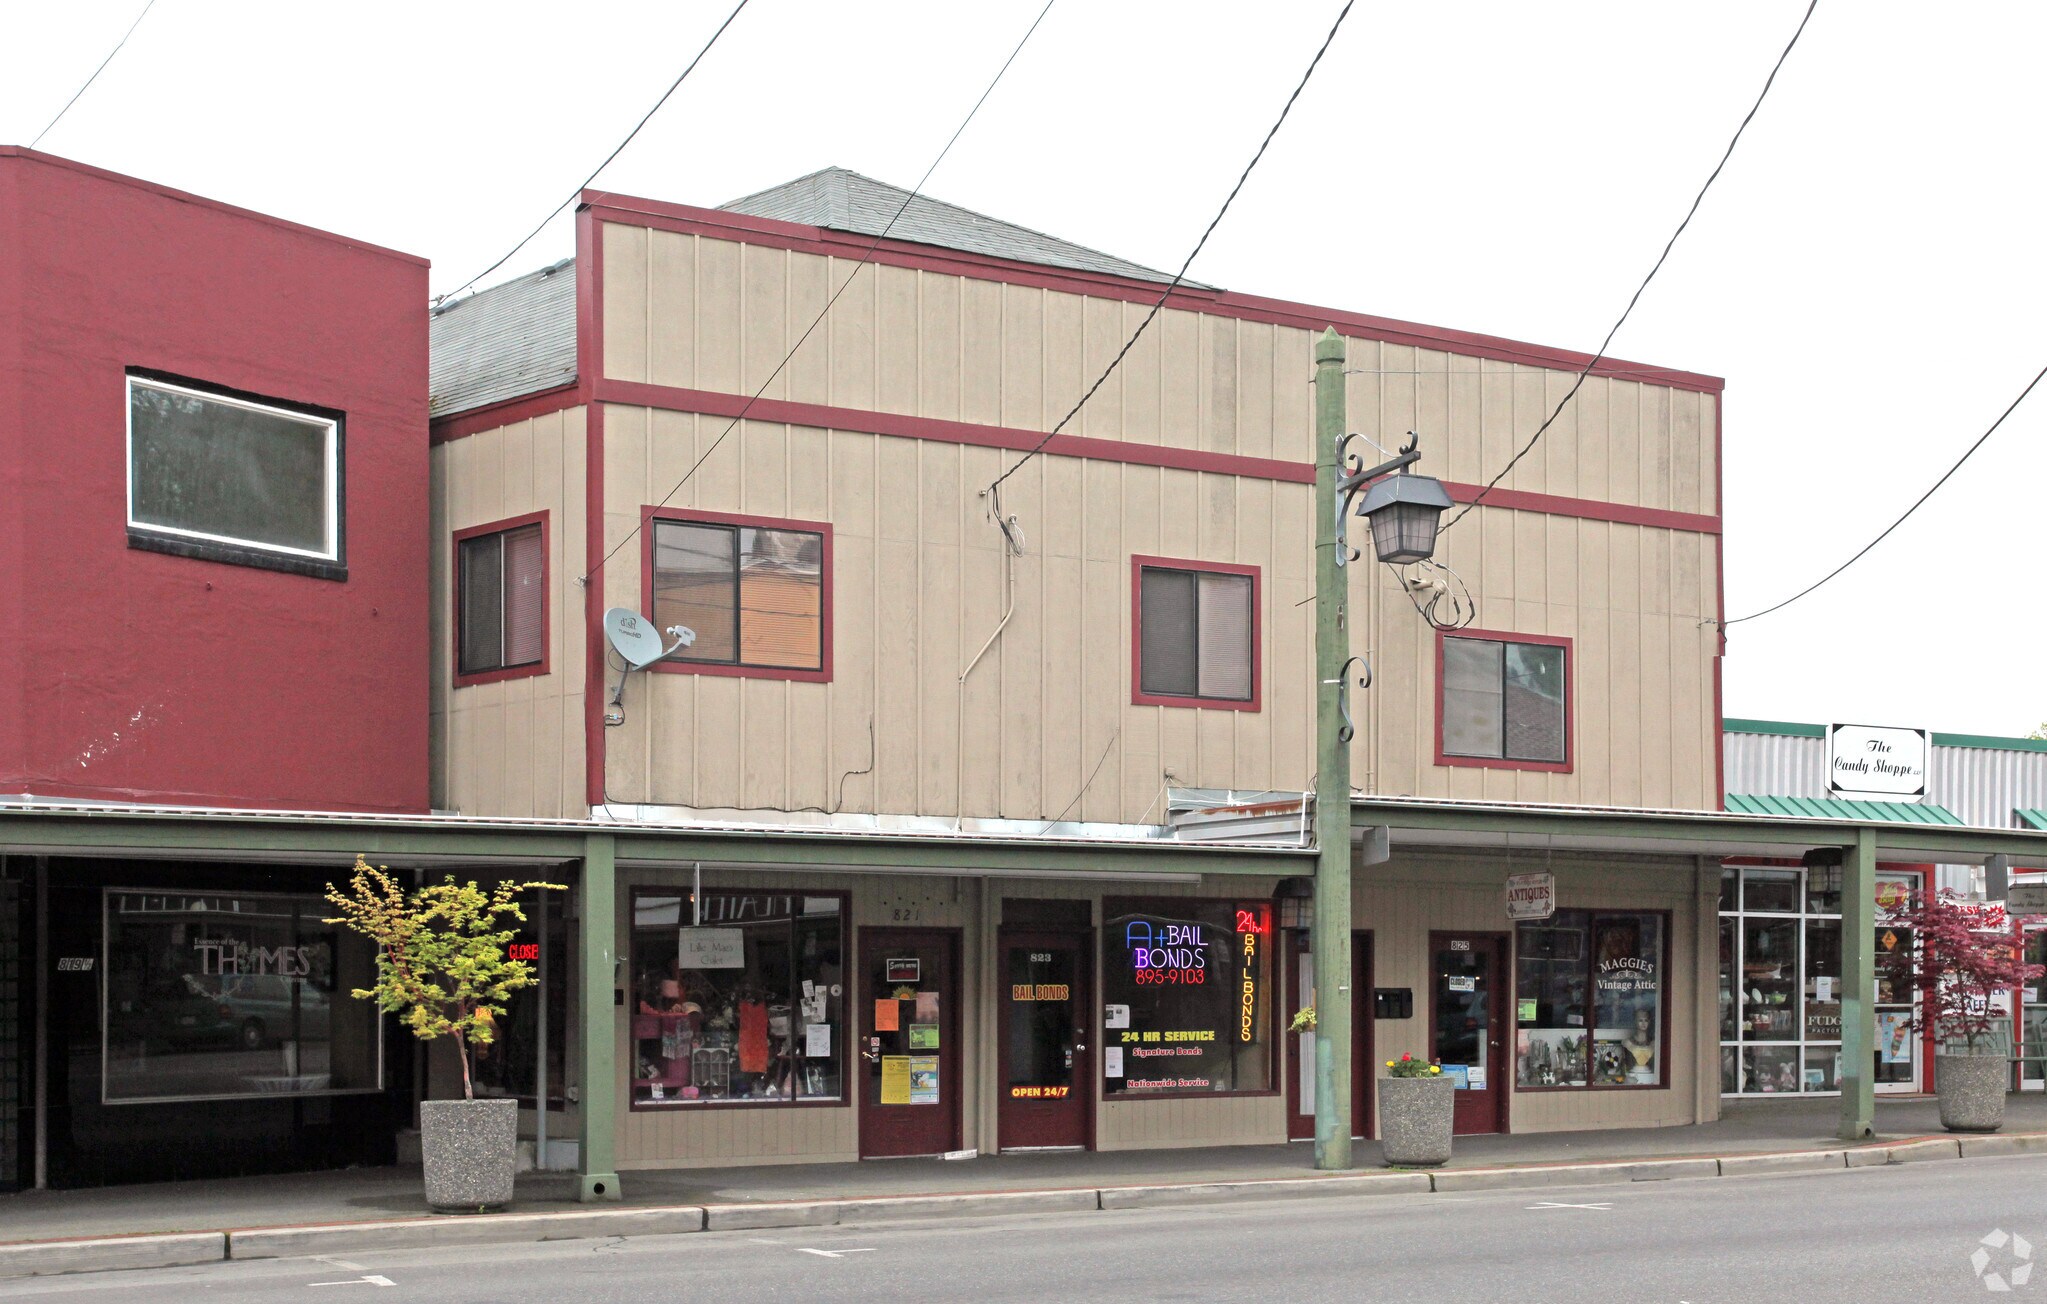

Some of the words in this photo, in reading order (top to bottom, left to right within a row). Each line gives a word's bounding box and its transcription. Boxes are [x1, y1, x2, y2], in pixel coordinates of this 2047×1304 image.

[1866, 739, 1892, 753] The
[1834, 755, 1869, 775] Candy
[1873, 758, 1912, 777] Shoppe
[1508, 886, 1550, 904] ANTIQUES
[893, 908, 920, 921] 821
[194, 937, 219, 945] Essence
[220, 937, 228, 945] of
[229, 937, 240, 945] the
[1167, 925, 1208, 946] BAIL
[509, 943, 539, 960] CLOSE
[1451, 940, 1470, 951] 825
[1030, 953, 1052, 962] 823
[1135, 947, 1205, 969] BONDS
[1599, 957, 1654, 974] MAGGIES
[1135, 968, 1205, 985] 895-9103
[1597, 979, 1632, 992] Vintage
[1633, 979, 1657, 990] Attic
[1012, 984, 1036, 1001] BAIL
[1036, 984, 1070, 1001] BONDS
[1808, 1015, 1841, 1026] FUDG
[1121, 1031, 1140, 1042] 24
[1143, 1031, 1161, 1042] HR
[1164, 1030, 1215, 1042] SERVICE
[1132, 1046, 1175, 1058] Signature
[1176, 1046, 1203, 1056] Bonds
[1126, 1078, 1177, 1089] Nationwide
[1178, 1078, 1210, 1088] Service
[1012, 1087, 1041, 1097] OPEN
[1044, 1086, 1069, 1097] 24/7
